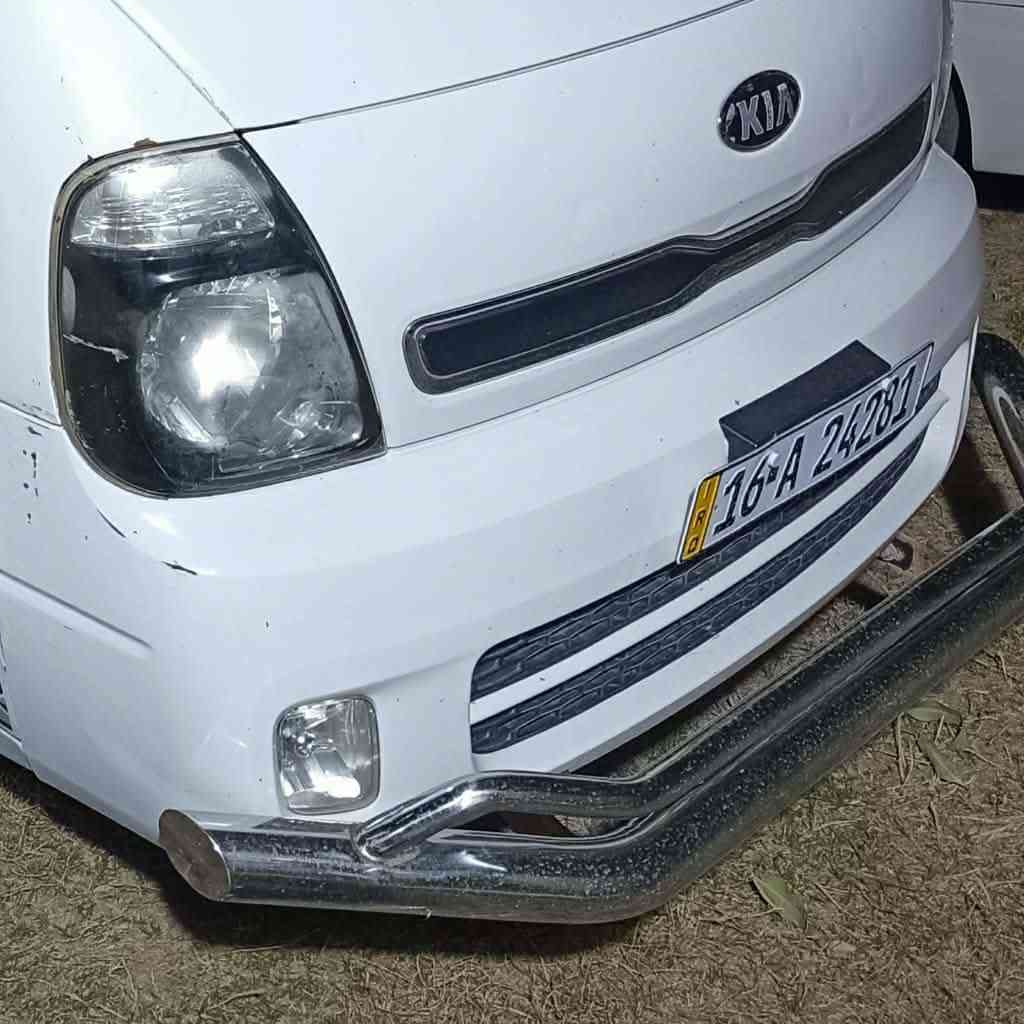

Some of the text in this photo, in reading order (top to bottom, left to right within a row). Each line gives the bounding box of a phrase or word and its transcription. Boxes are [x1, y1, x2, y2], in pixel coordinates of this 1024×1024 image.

[736, 82, 795, 141] KIA
[713, 364, 917, 535] 16 A 24281
